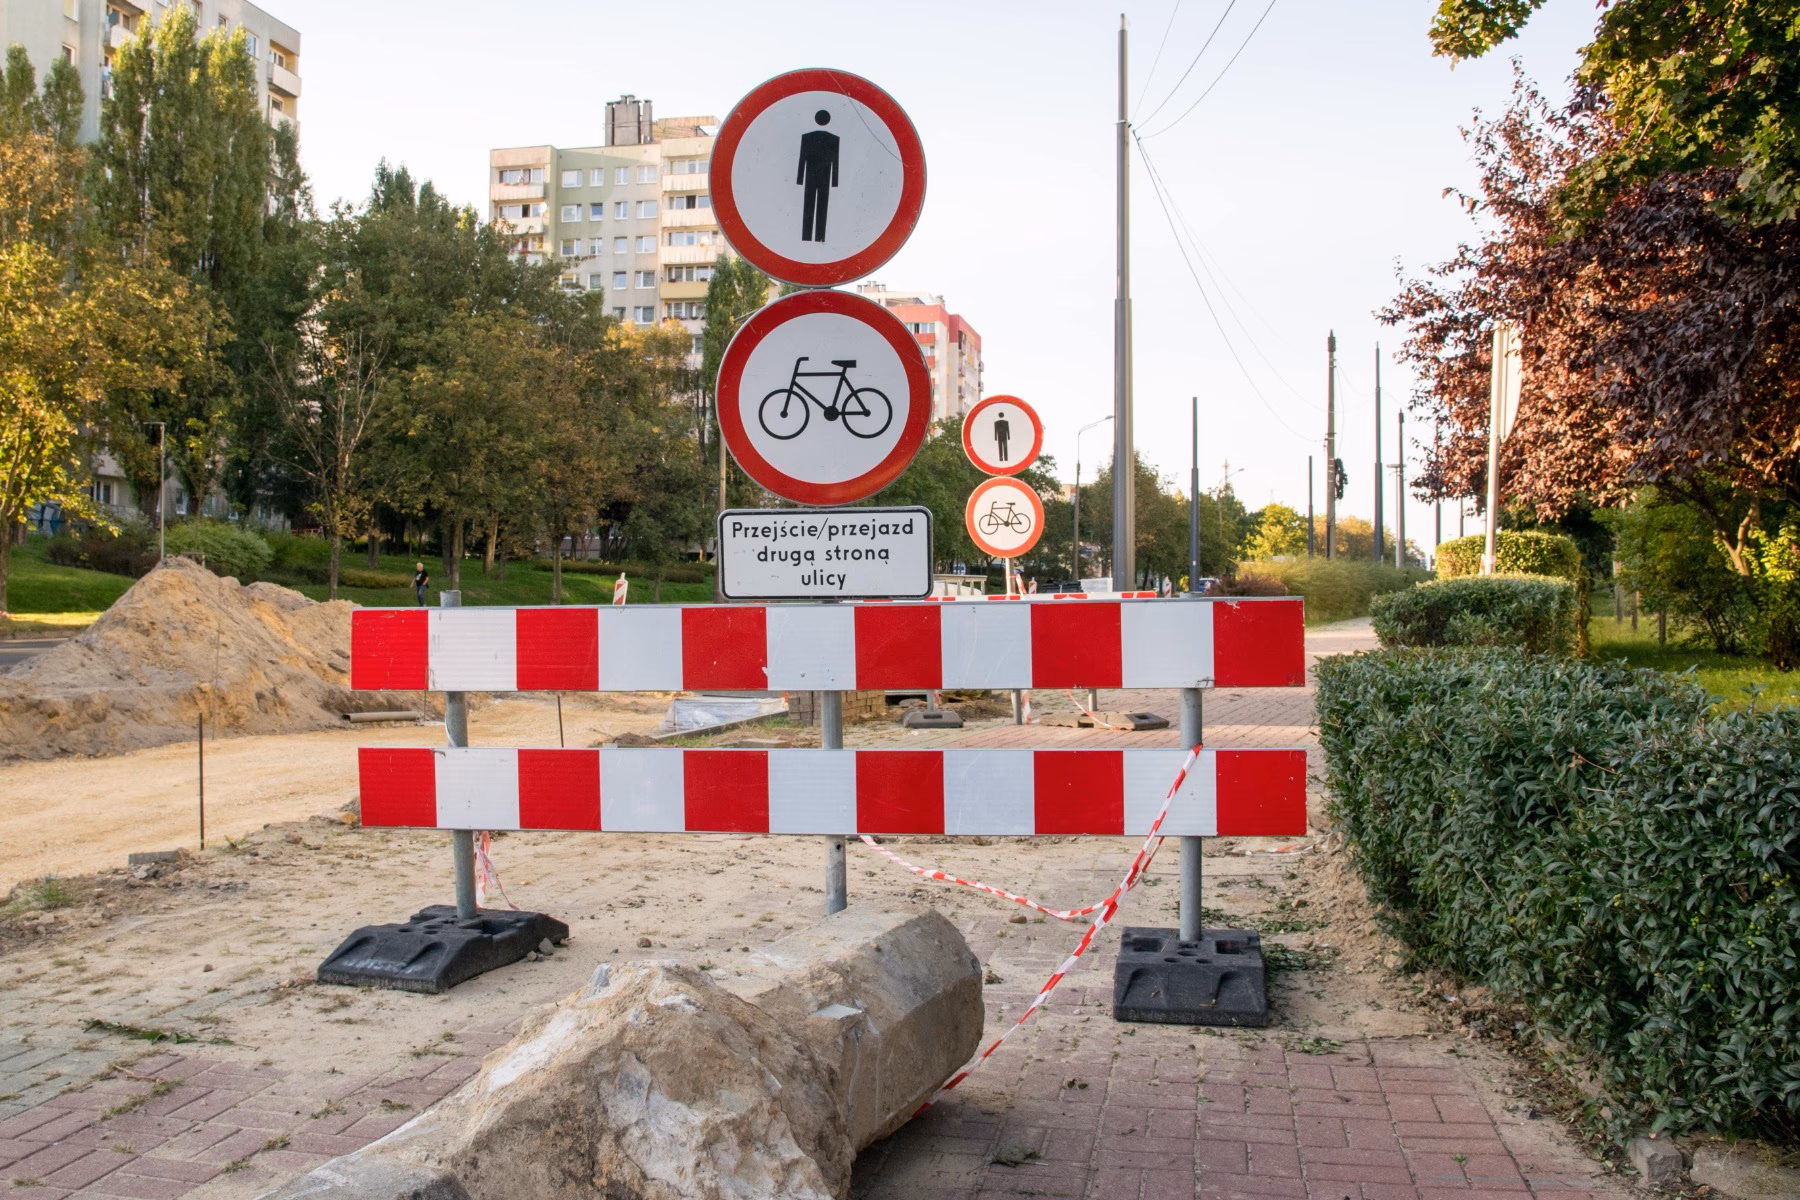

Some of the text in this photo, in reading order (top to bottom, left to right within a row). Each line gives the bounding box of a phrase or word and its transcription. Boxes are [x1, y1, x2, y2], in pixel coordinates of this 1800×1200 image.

[732, 518, 914, 542] Przejście/przejazd
[757, 545, 890, 566] drugą stroną
[801, 569, 847, 590] ulicy
